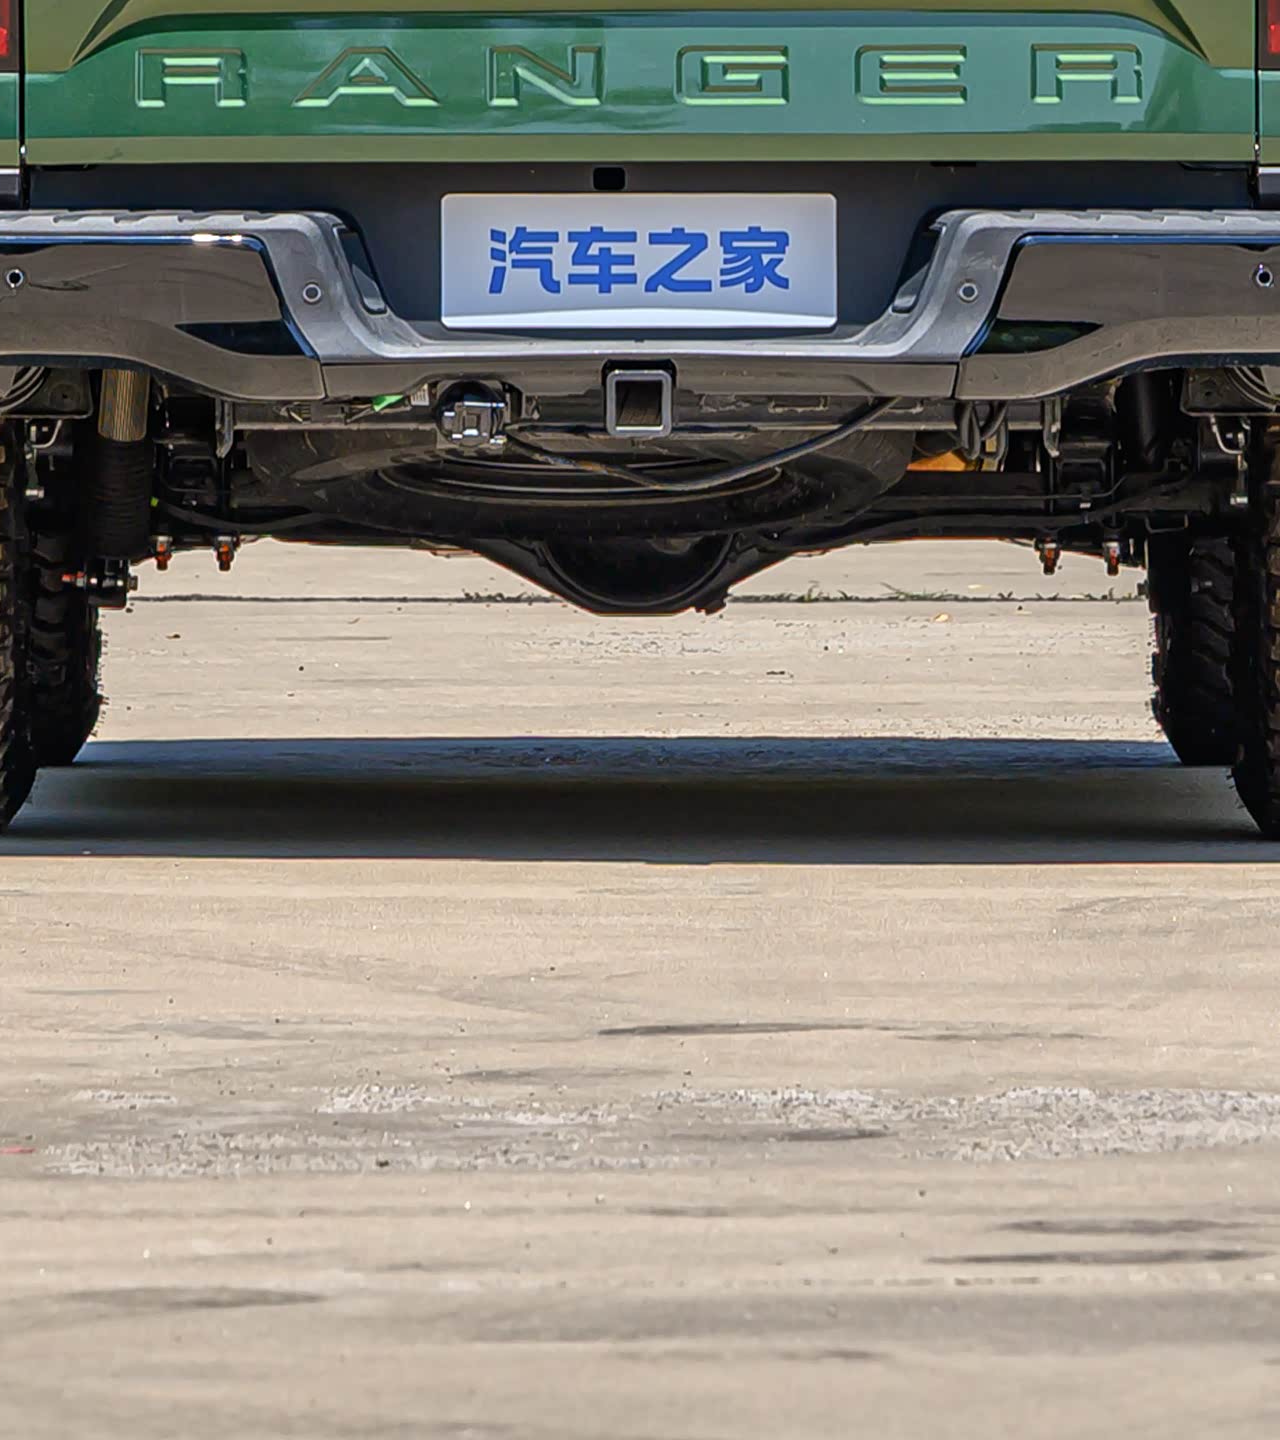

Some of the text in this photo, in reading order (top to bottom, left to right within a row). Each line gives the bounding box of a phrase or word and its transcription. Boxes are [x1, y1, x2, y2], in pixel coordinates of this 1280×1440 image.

[133, 42, 1144, 109] RANGER
[488, 225, 790, 294] 汽车之家
